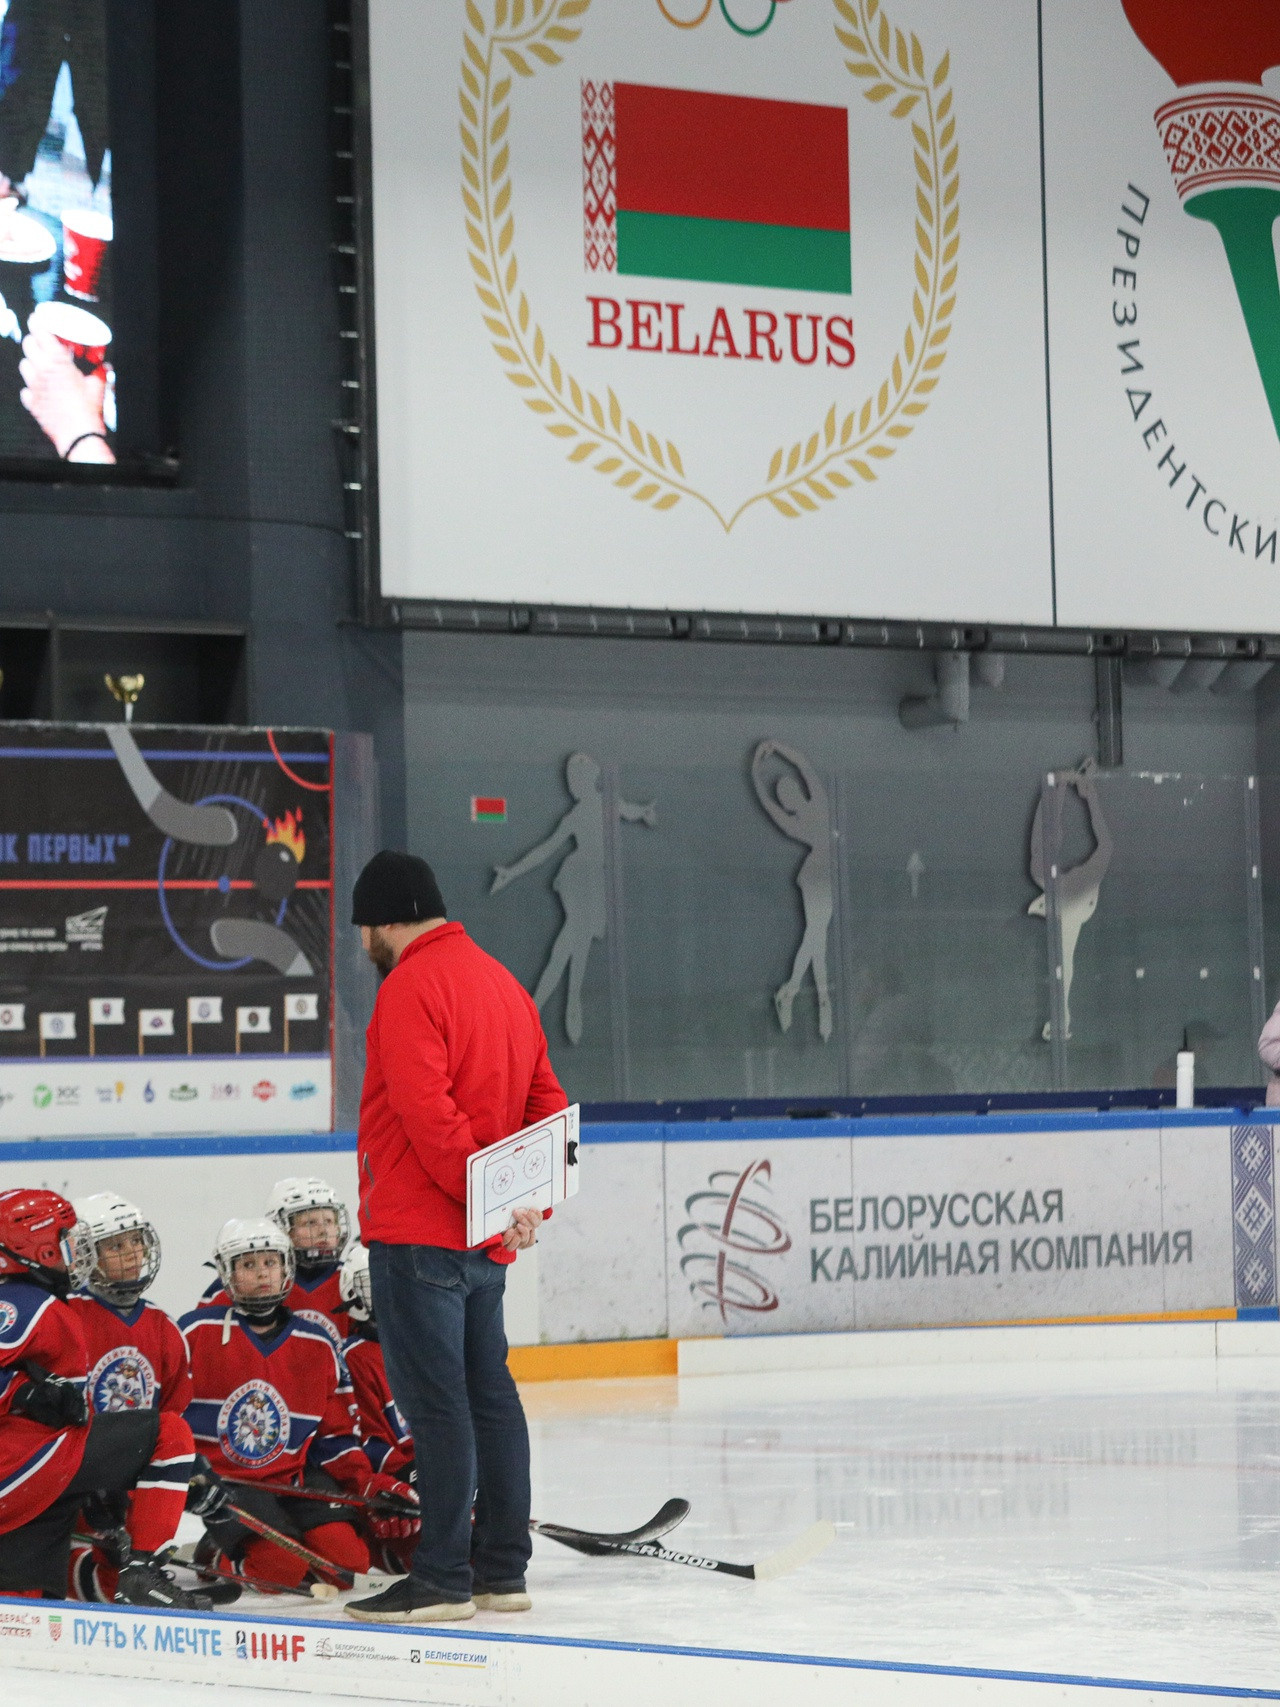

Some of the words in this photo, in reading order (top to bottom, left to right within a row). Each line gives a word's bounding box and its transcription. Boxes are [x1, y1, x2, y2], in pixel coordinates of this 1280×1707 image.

[585, 296, 856, 368] BELARUS
[27, 833, 130, 864] ПЕРВЫХ"
[810, 1188, 1064, 1235] БЕЛОРУССКАЯ
[810, 1231, 1000, 1283] КАЛИЙНАЯ
[1011, 1228, 1193, 1274] КОМПАНИЯ
[74, 1618, 127, 1649] ПУТЬ
[133, 1623, 148, 1650] К
[155, 1625, 222, 1656] МЕЧТЕ
[251, 1632, 306, 1662] IIHF
[424, 1650, 488, 1663] БЕЛНЕФТЕХИМ
